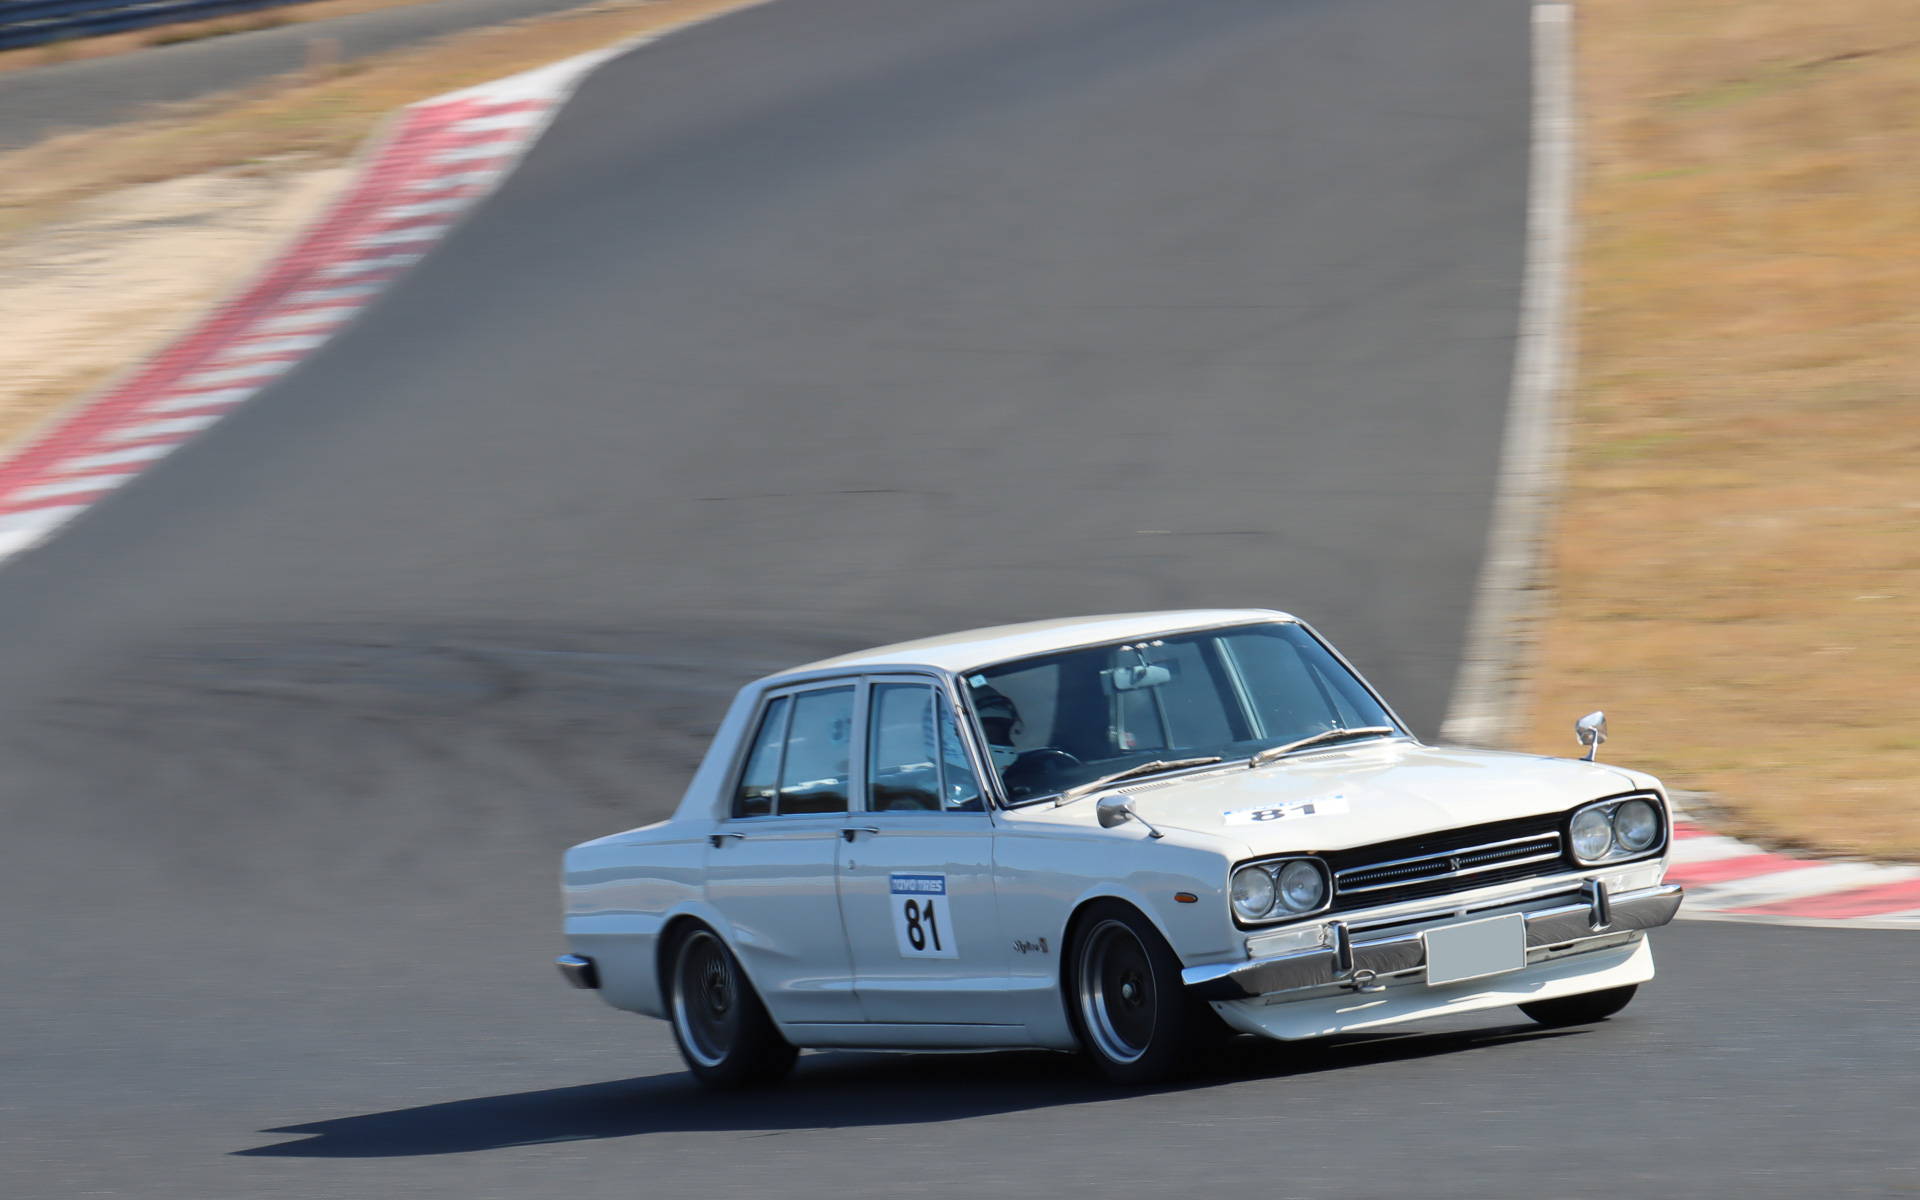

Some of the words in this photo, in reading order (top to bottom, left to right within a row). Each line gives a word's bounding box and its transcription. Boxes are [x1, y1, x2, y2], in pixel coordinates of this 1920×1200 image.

[1251, 804, 1316, 821] 81
[1450, 857, 1460, 870] N
[904, 898, 942, 951] 81
